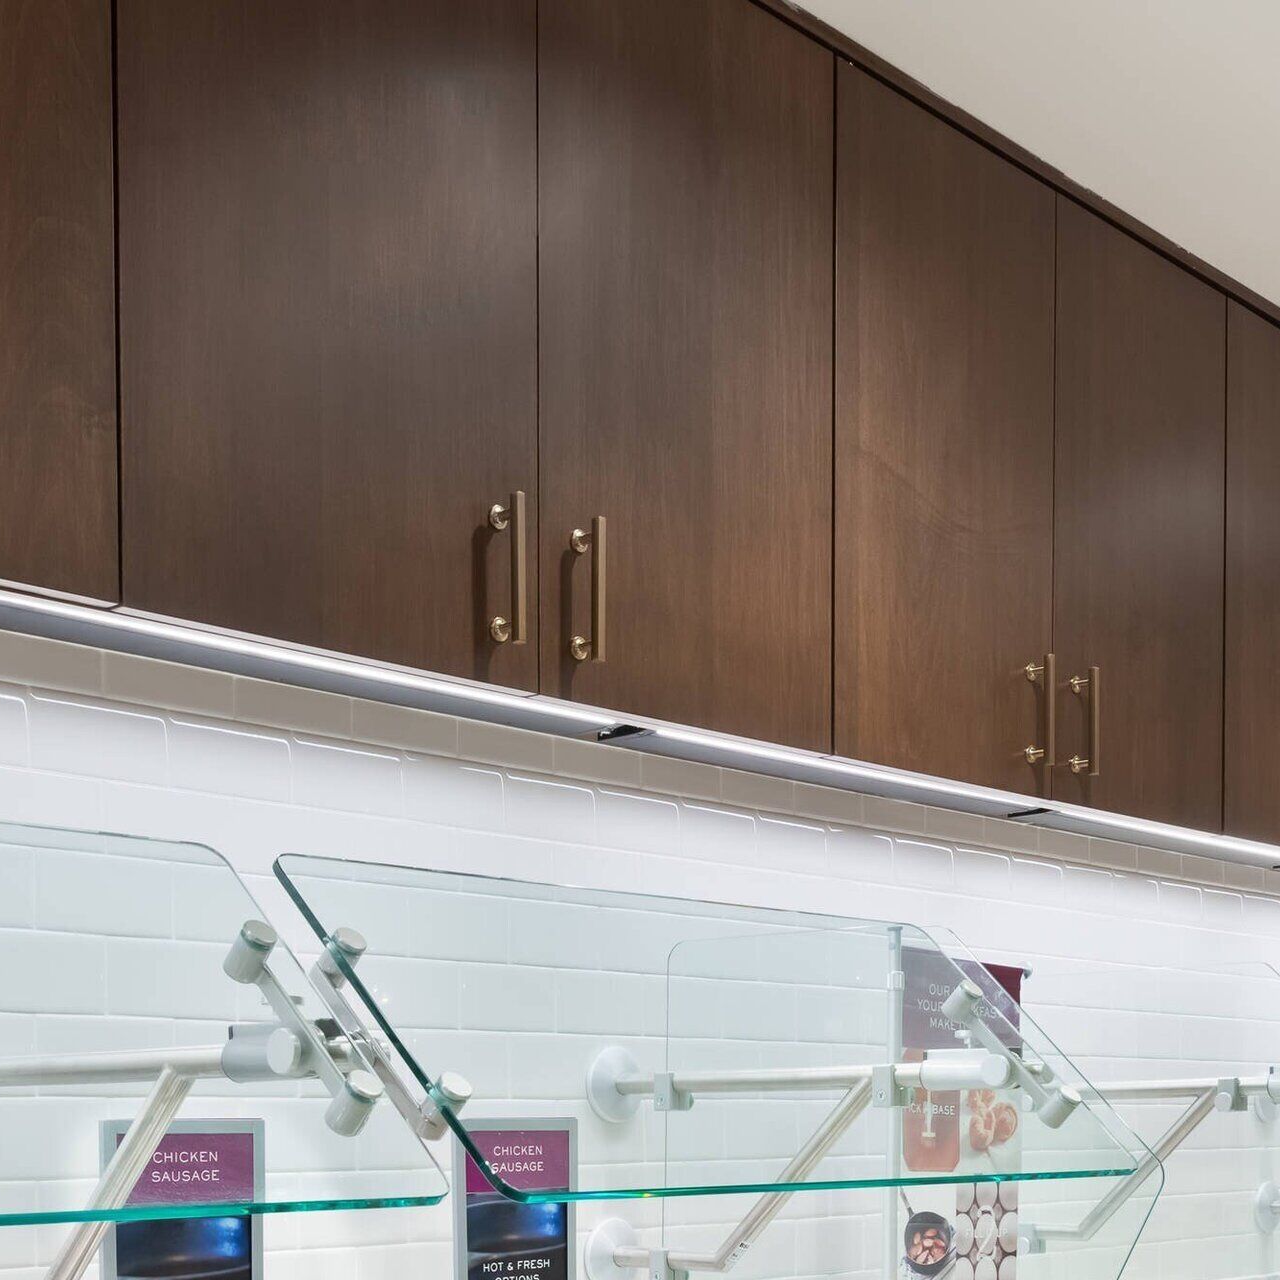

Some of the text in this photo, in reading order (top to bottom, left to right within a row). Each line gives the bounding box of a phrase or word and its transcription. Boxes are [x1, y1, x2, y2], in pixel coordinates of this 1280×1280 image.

[932, 1105, 956, 1116] BASE
[492, 1145, 543, 1157] CHICKEN
[152, 1151, 219, 1164] CHICKEN
[491, 1161, 545, 1173] SAUSAGE
[151, 1169, 220, 1183] SAUSAGE
[482, 1258, 551, 1273] HOT & FRESH
